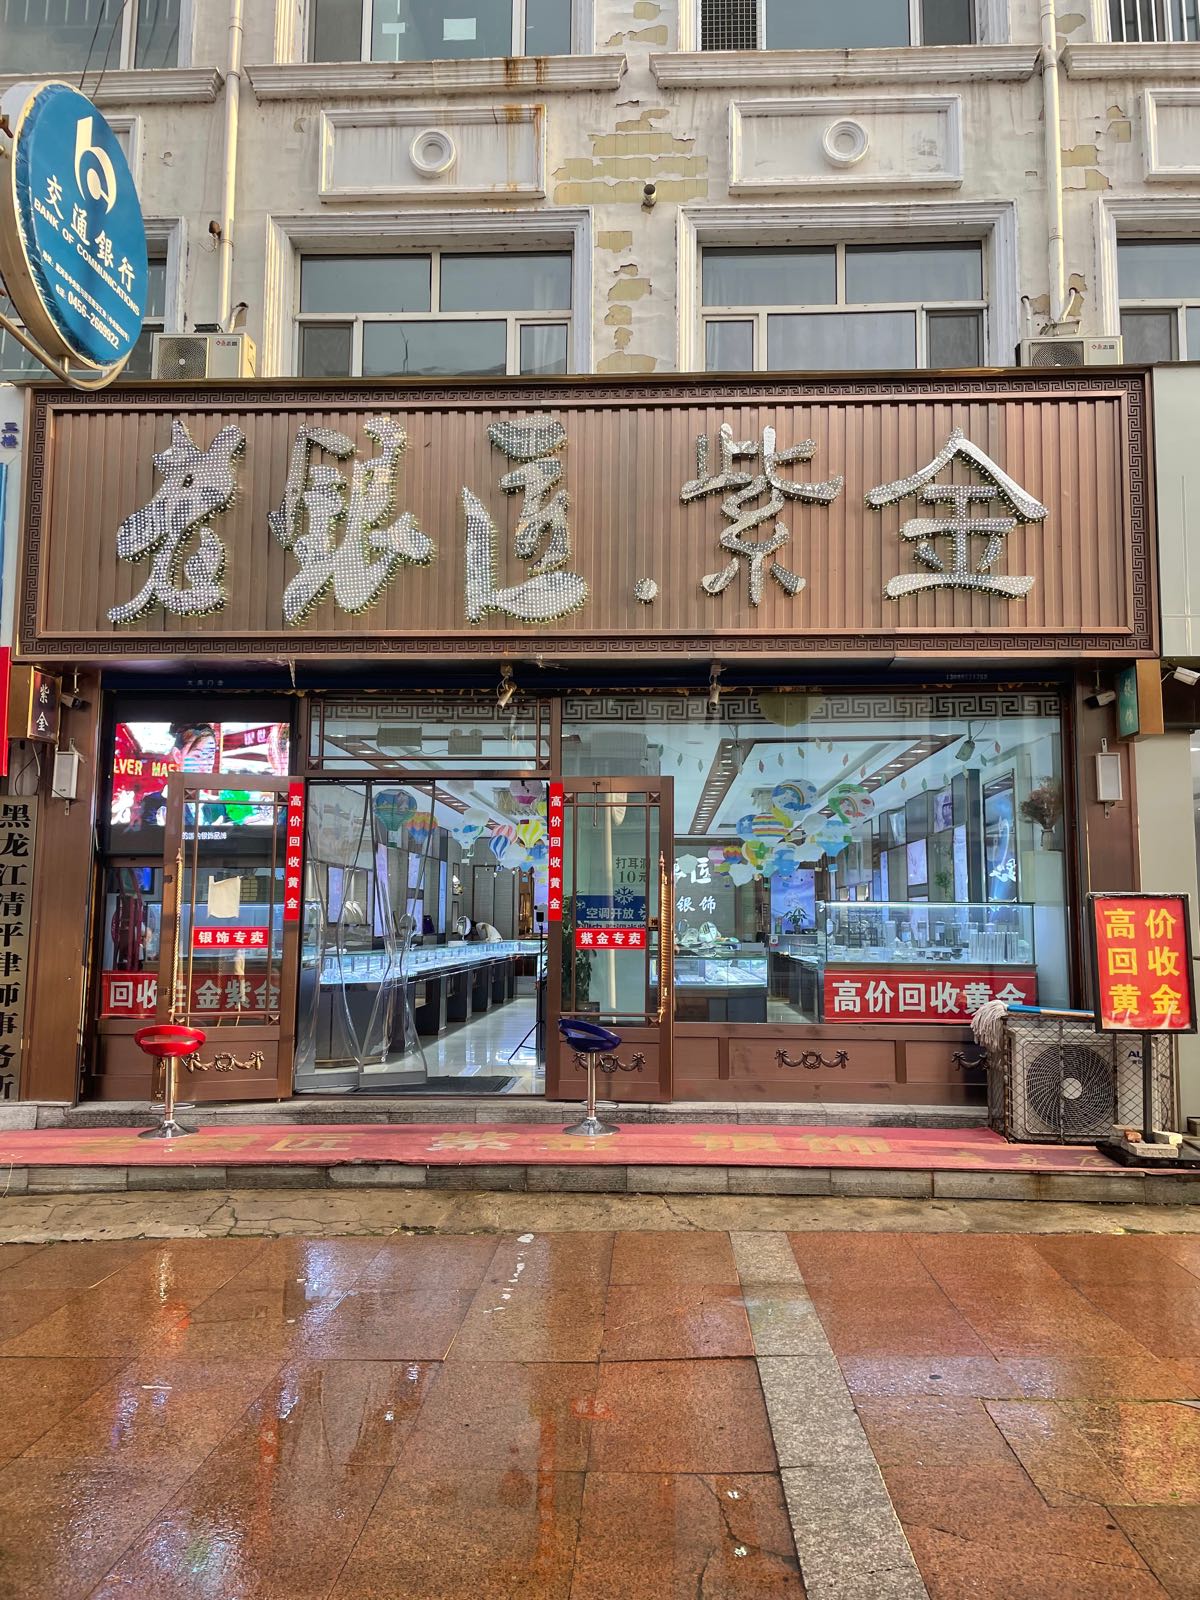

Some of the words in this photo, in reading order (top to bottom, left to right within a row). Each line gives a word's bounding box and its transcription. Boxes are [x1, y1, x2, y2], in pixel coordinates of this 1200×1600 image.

[44, 174, 135, 292] 交通銀行
[33, 197, 59, 231] BANK
[62, 228, 75, 244] OF
[76, 243, 140, 317] COMMUNICATIONS
[36, 684, 50, 731] 紫金
[286, 795, 302, 909] 高价回收黄金
[550, 796, 561, 910] 高价回收黄金
[586, 907, 634, 919] 空调开放
[676, 896, 717, 914] 银饰
[198, 931, 264, 944] 银饰专卖
[580, 932, 641, 945] 紫金专卖
[1104, 908, 1177, 939] 高价
[1107, 946, 1180, 977] 回收
[832, 980, 1026, 1014] 高价回收黄金
[1108, 984, 1182, 1015] 黄金
